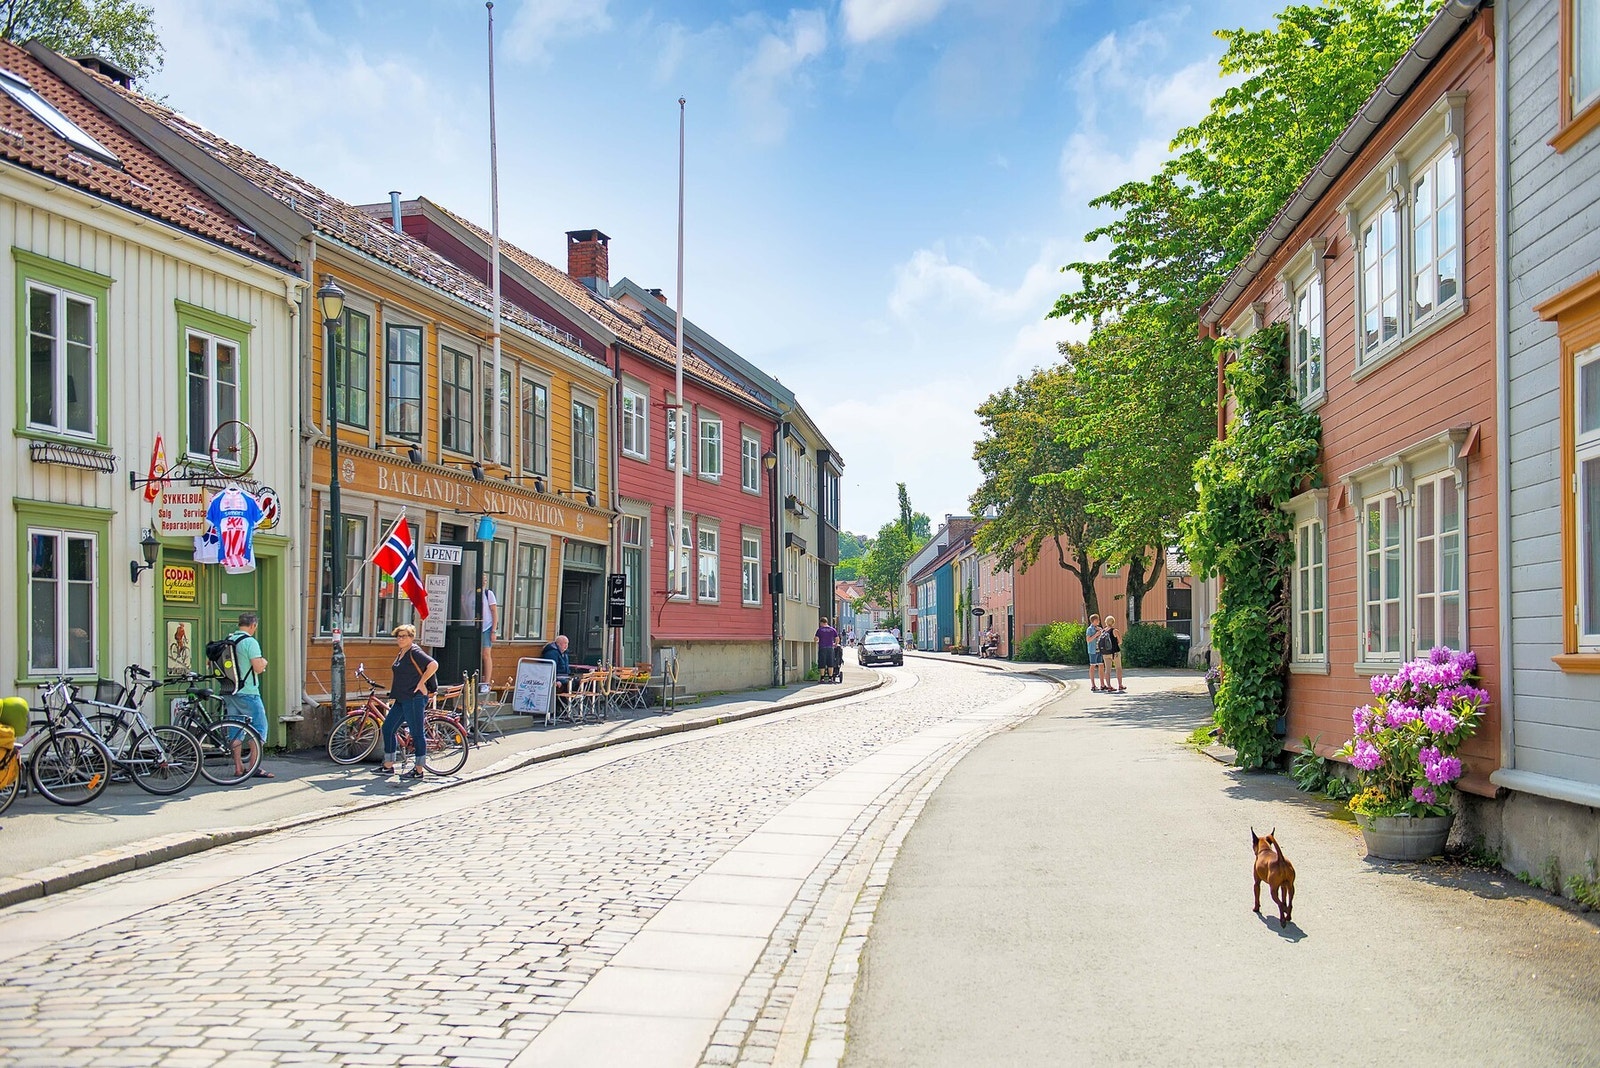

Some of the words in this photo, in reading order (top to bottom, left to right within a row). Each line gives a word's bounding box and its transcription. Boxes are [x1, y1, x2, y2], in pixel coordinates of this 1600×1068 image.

[162, 493, 203, 504] SYKKELBUA
[378, 466, 472, 507] BAKLANDET
[483, 489, 565, 527] SKYDSSTATION
[158, 508, 171, 519] Salg
[183, 508, 206, 518] Service
[161, 520, 204, 531] Reparasjoner
[165, 568, 194, 580] CODAN
